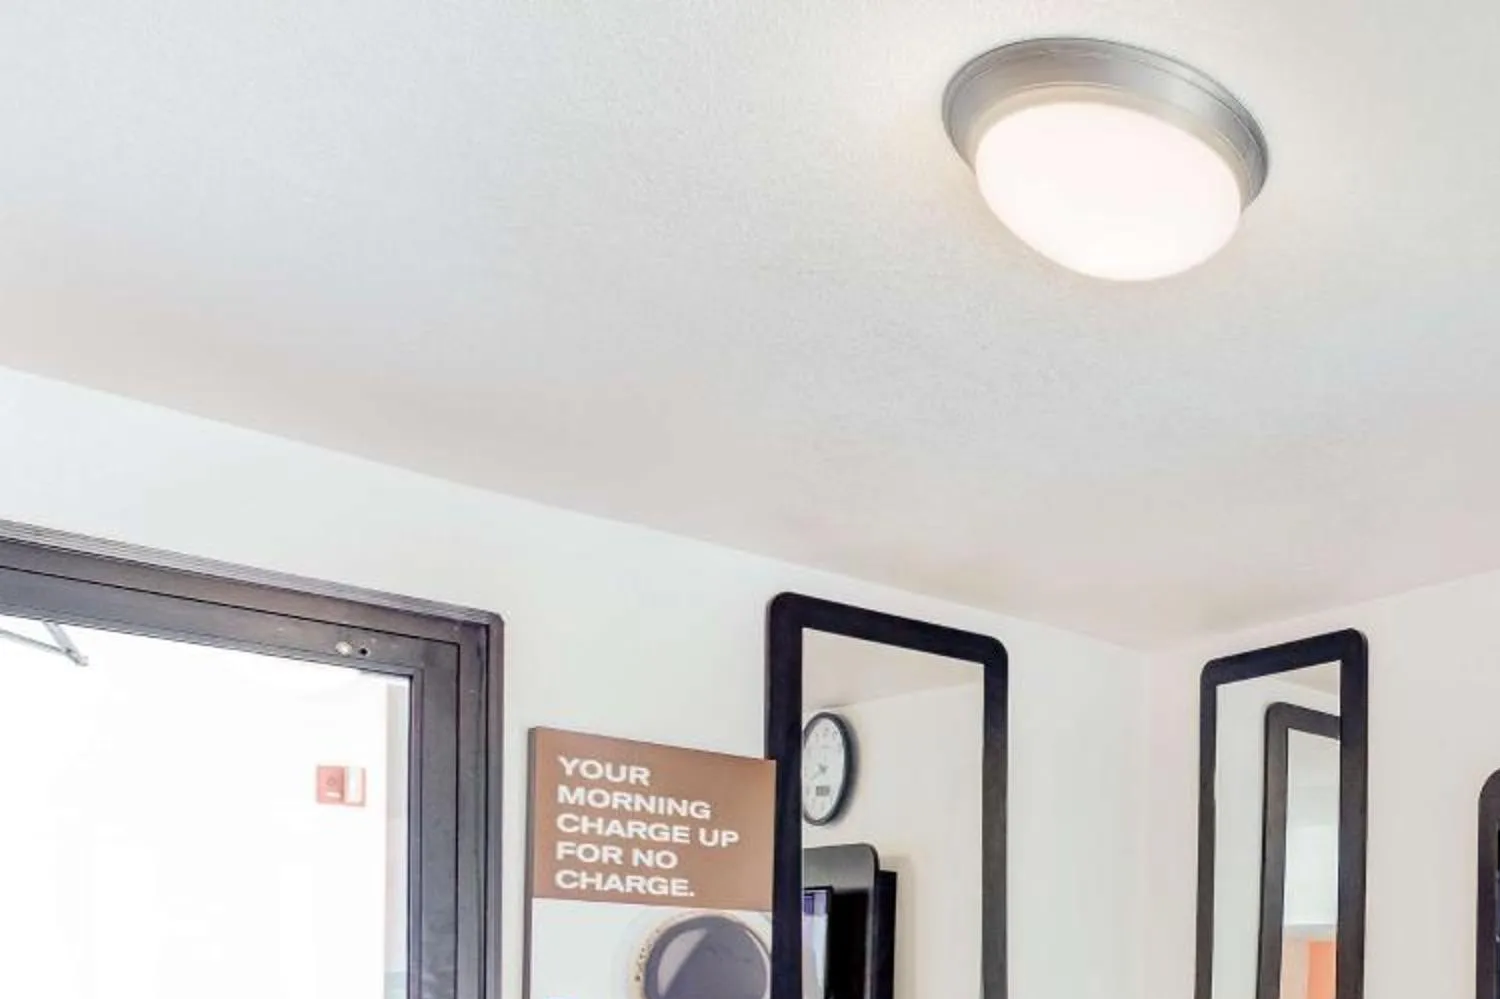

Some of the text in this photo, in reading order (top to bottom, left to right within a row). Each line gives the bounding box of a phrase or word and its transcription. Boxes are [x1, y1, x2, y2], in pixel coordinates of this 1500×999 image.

[557, 755, 651, 786] YOUR
[556, 785, 711, 820] MORNING
[556, 813, 739, 848] CHARGE UP
[556, 842, 677, 869] FOR NO
[555, 869, 695, 898] CHARGE.
